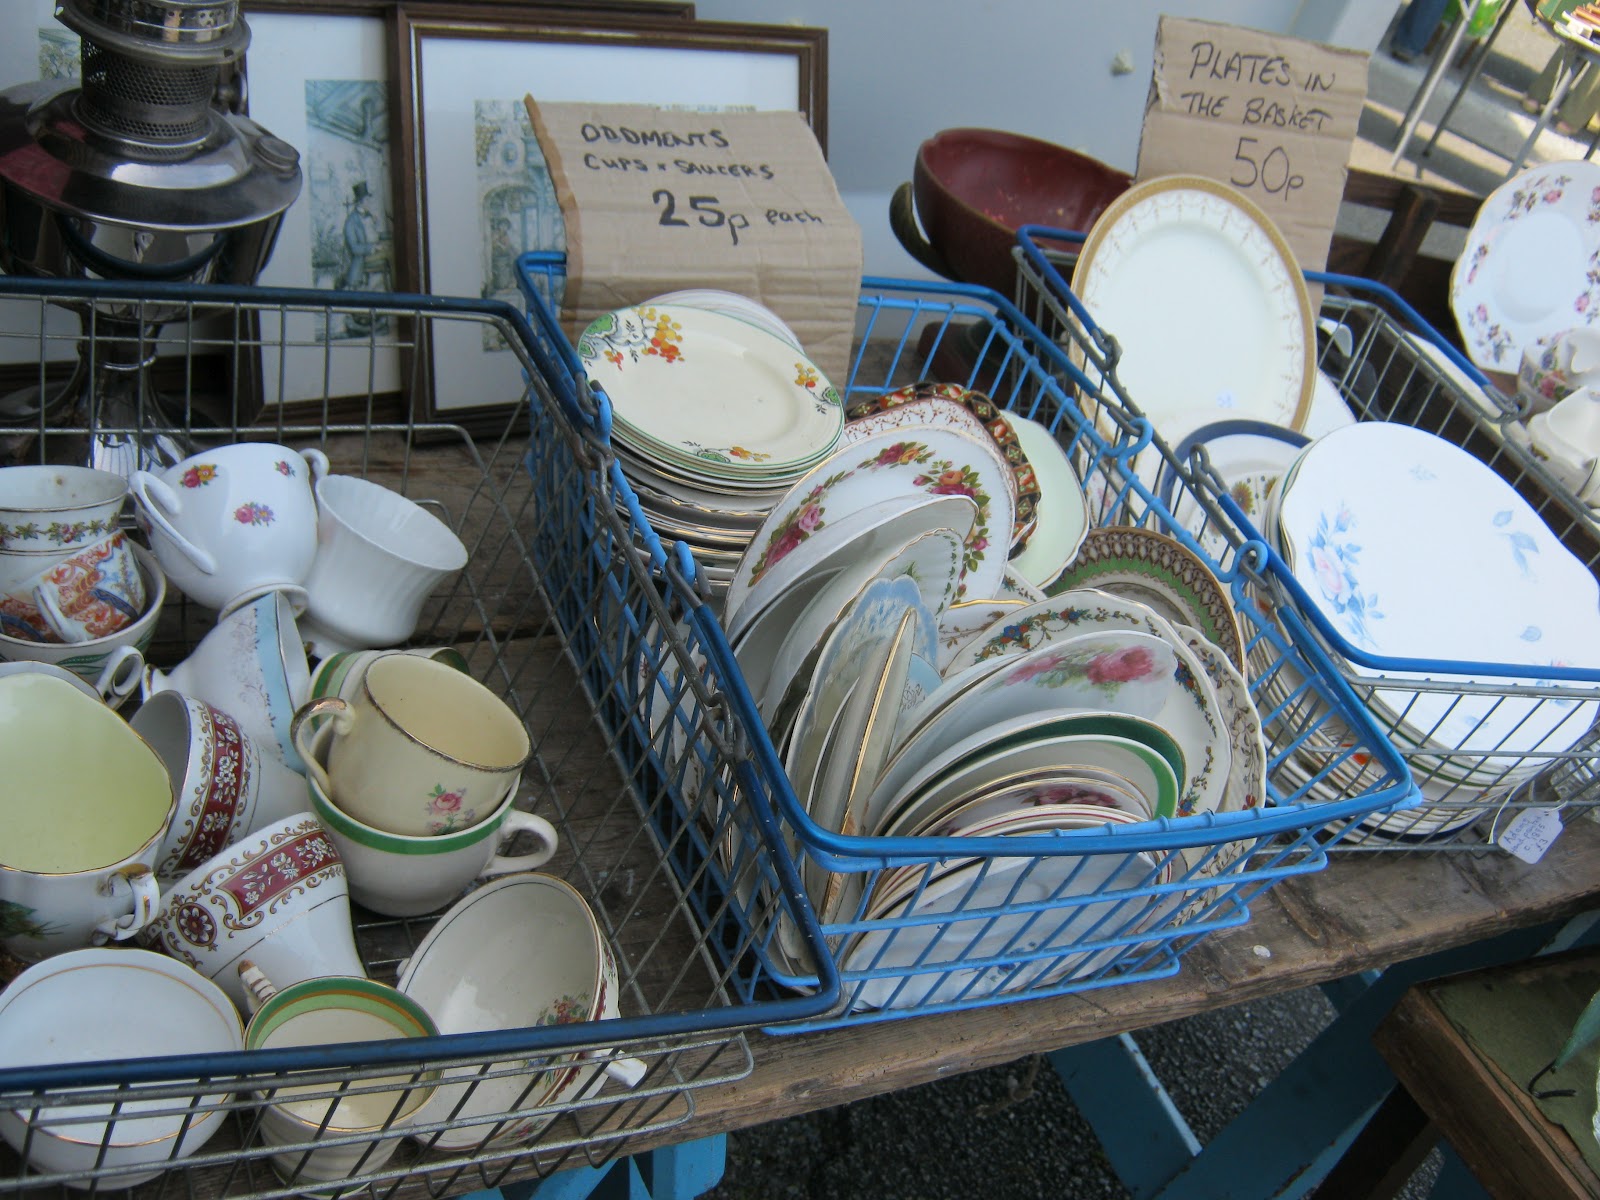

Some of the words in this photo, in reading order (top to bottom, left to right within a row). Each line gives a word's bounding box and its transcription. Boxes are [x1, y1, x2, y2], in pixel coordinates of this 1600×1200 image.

[1189, 41, 1291, 86] PLATES
[1304, 73, 1336, 91] IN
[1181, 92, 1229, 117] THE
[1242, 98, 1333, 130] BASKET
[580, 122, 730, 148] ODDMENTS
[673, 158, 775, 181] SAUCERS
[1230, 137, 1304, 200] 50p
[652, 189, 749, 245] 25p
